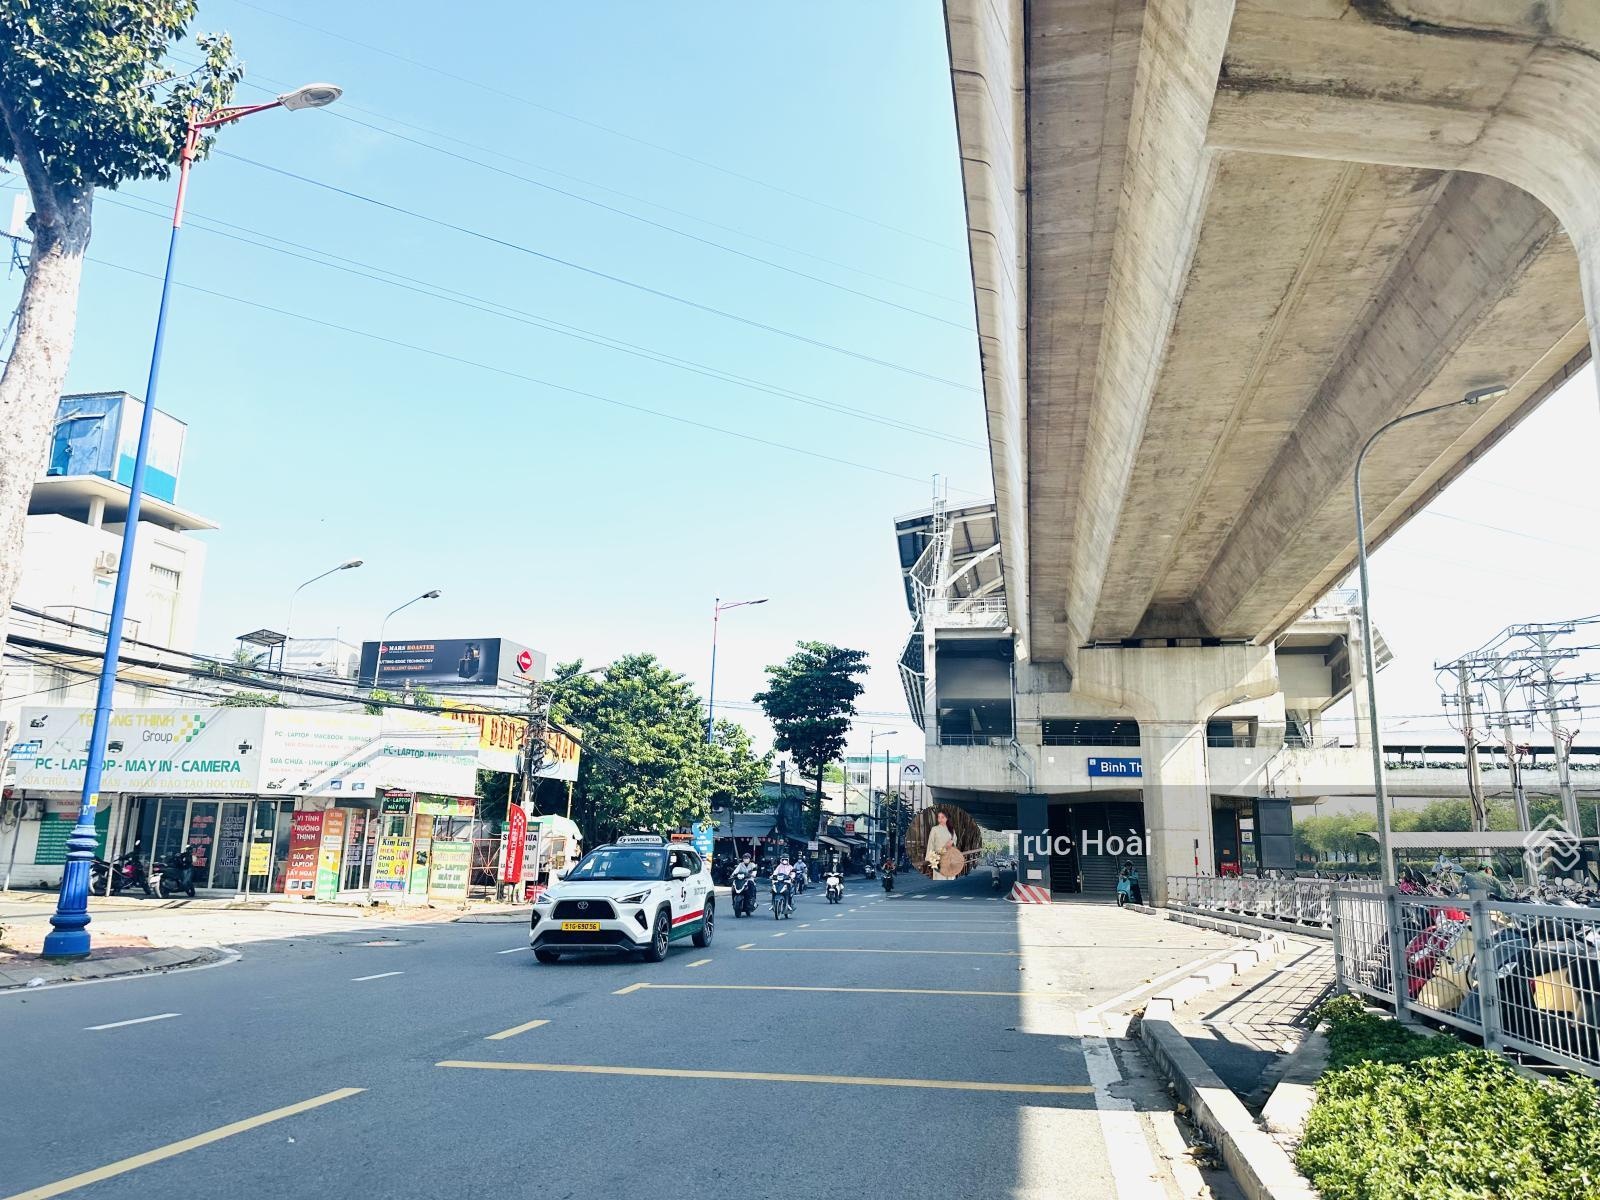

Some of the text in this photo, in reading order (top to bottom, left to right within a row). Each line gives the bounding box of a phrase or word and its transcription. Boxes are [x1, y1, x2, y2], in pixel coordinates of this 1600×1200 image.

[142, 730, 173, 743] Group
[397, 748, 425, 758] LAPTOP
[35, 758, 52, 770] PC
[158, 760, 173, 773] IN
[181, 760, 241, 773] CAMERA
[1100, 761, 1127, 773] Bình
[382, 838, 396, 846] Kim
